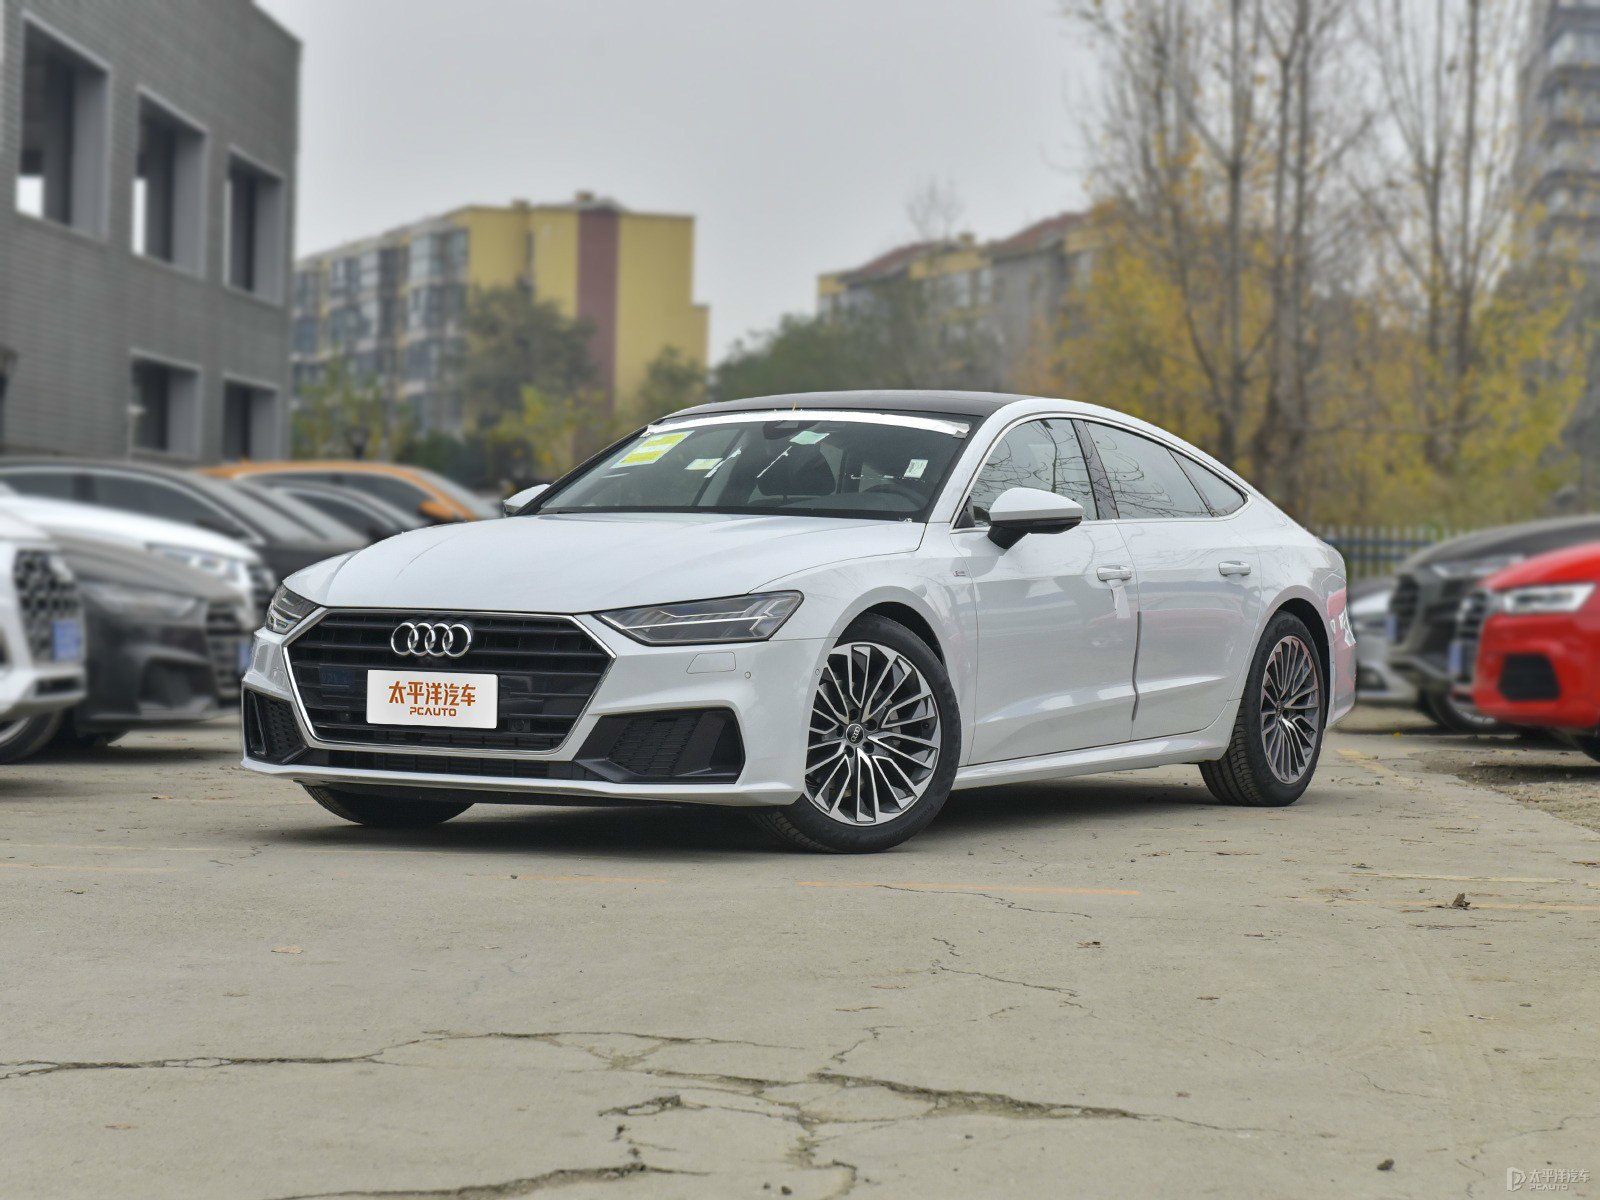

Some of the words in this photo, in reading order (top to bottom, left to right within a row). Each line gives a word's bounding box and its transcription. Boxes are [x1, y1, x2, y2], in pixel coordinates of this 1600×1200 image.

[388, 680, 476, 706] 太平洋汽车
[409, 706, 457, 717] PCAUTO
